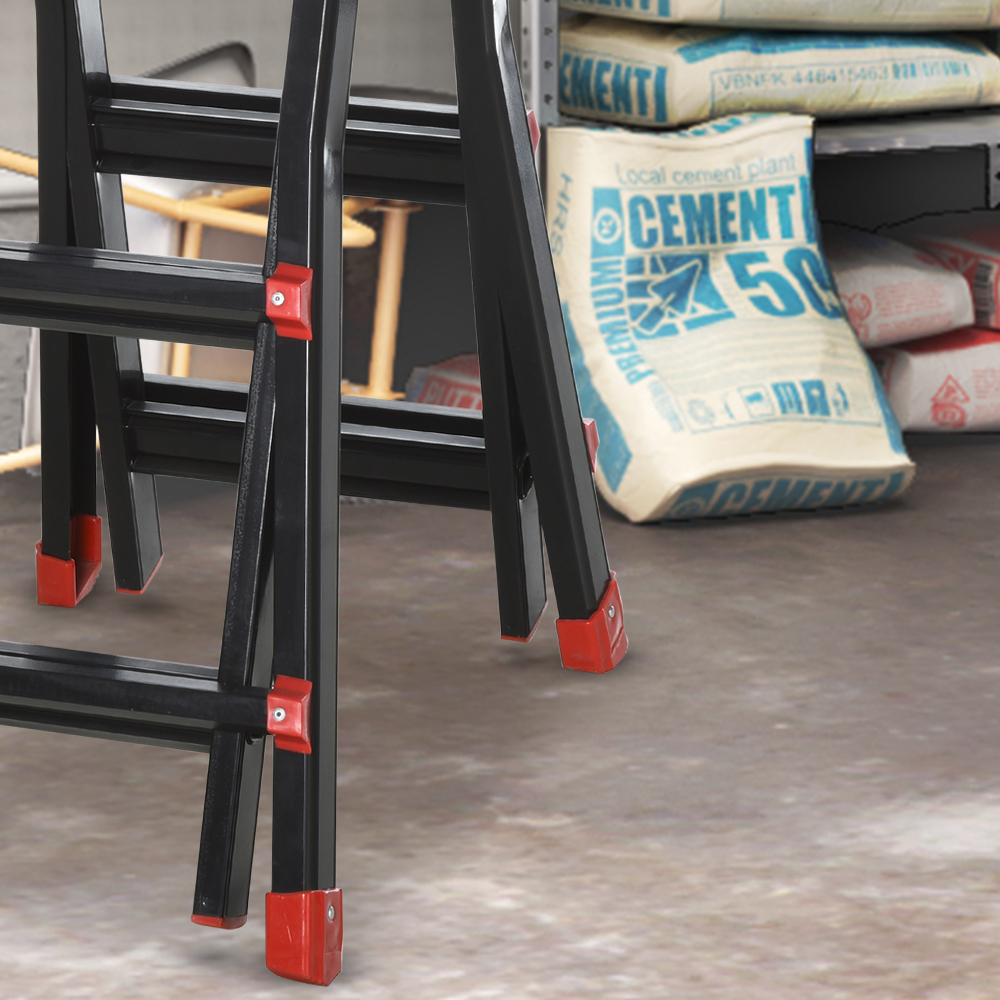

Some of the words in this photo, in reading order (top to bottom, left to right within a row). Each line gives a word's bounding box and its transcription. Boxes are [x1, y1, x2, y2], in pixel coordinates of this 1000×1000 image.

[615, 163, 667, 185] Local
[672, 165, 743, 185] cement
[747, 154, 798, 182] plant
[627, 184, 796, 249] CEMENT
[725, 247, 844, 320] 50
[590, 258, 655, 386] PREMIUM
